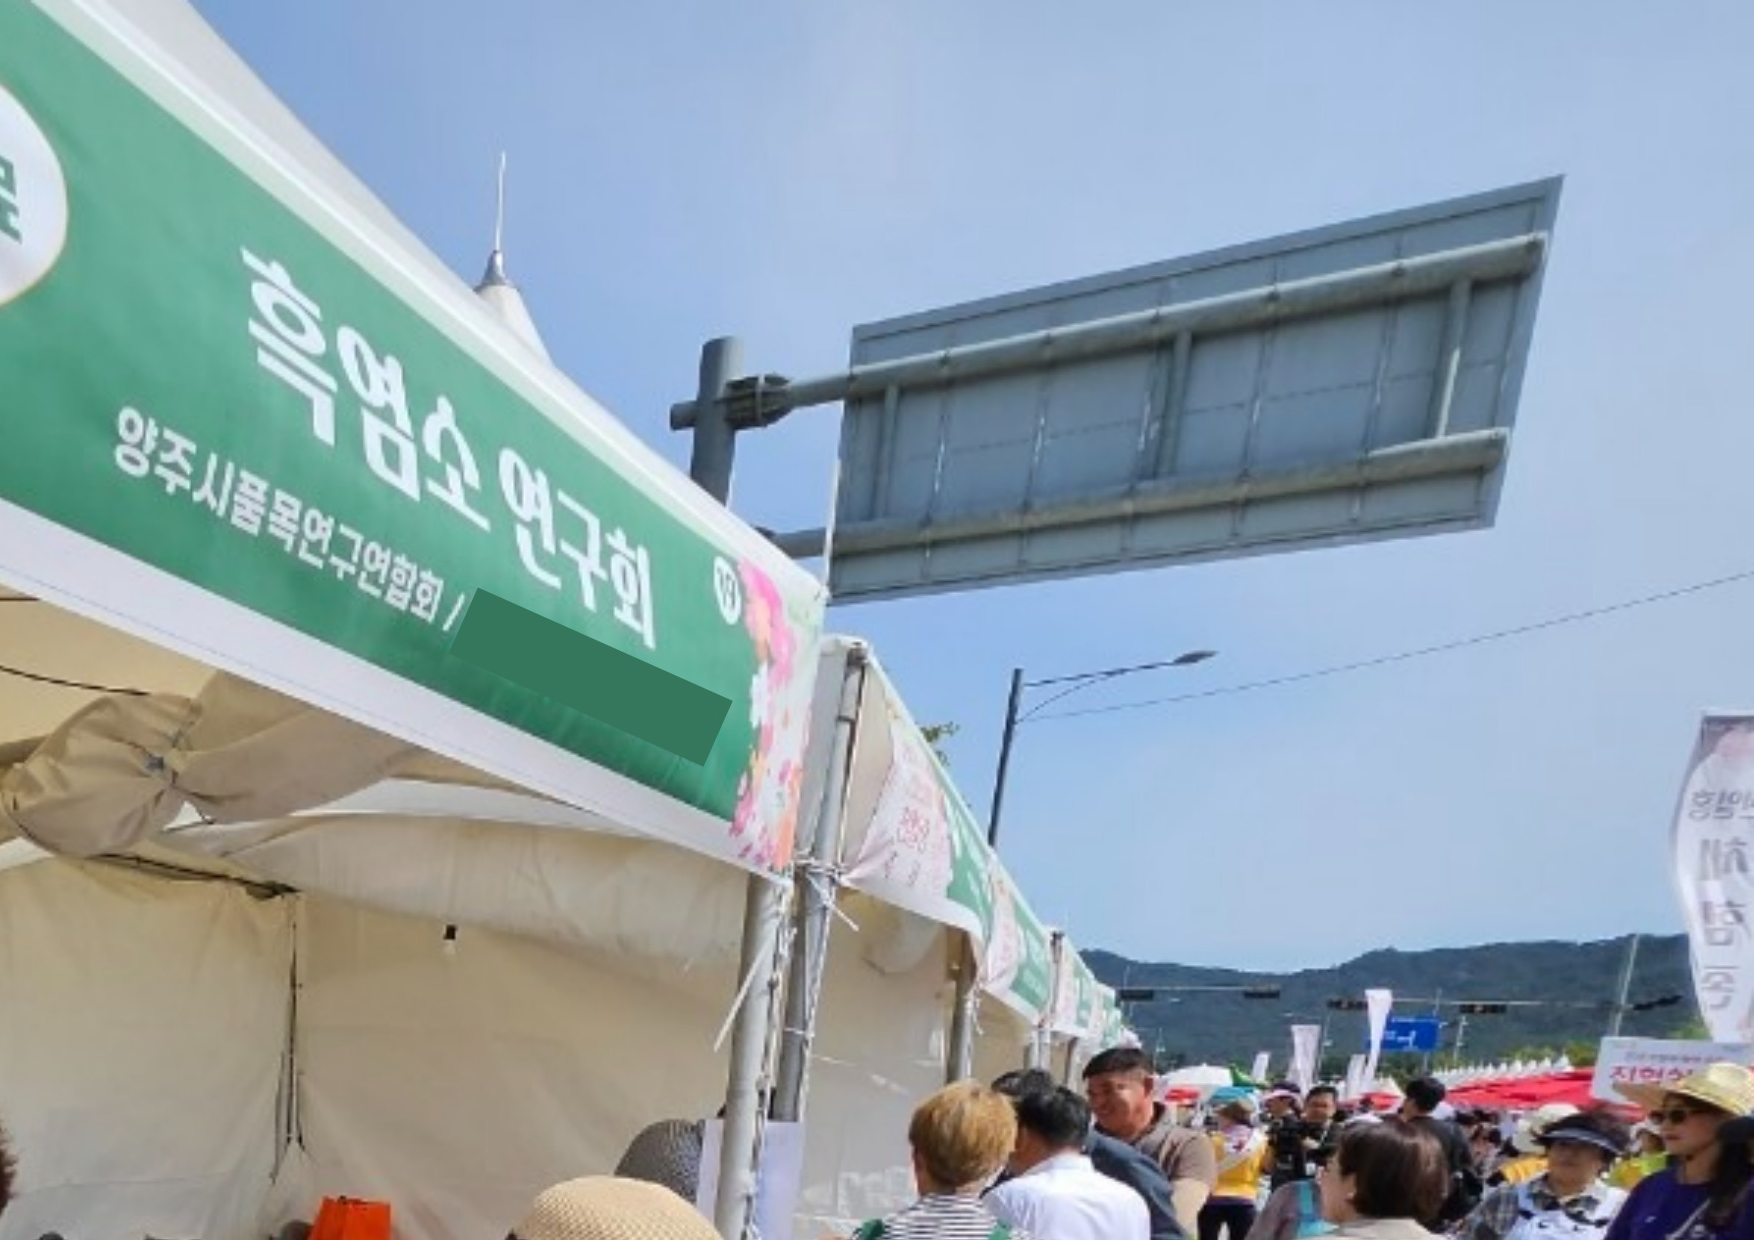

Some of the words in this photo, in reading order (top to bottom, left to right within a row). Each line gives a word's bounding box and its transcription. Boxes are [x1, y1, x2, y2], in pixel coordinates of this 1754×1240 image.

[114, 405, 444, 624] 양주시품목연구연합회
[241, 246, 490, 530] 흑염소
[498, 447, 655, 649] 연구회
